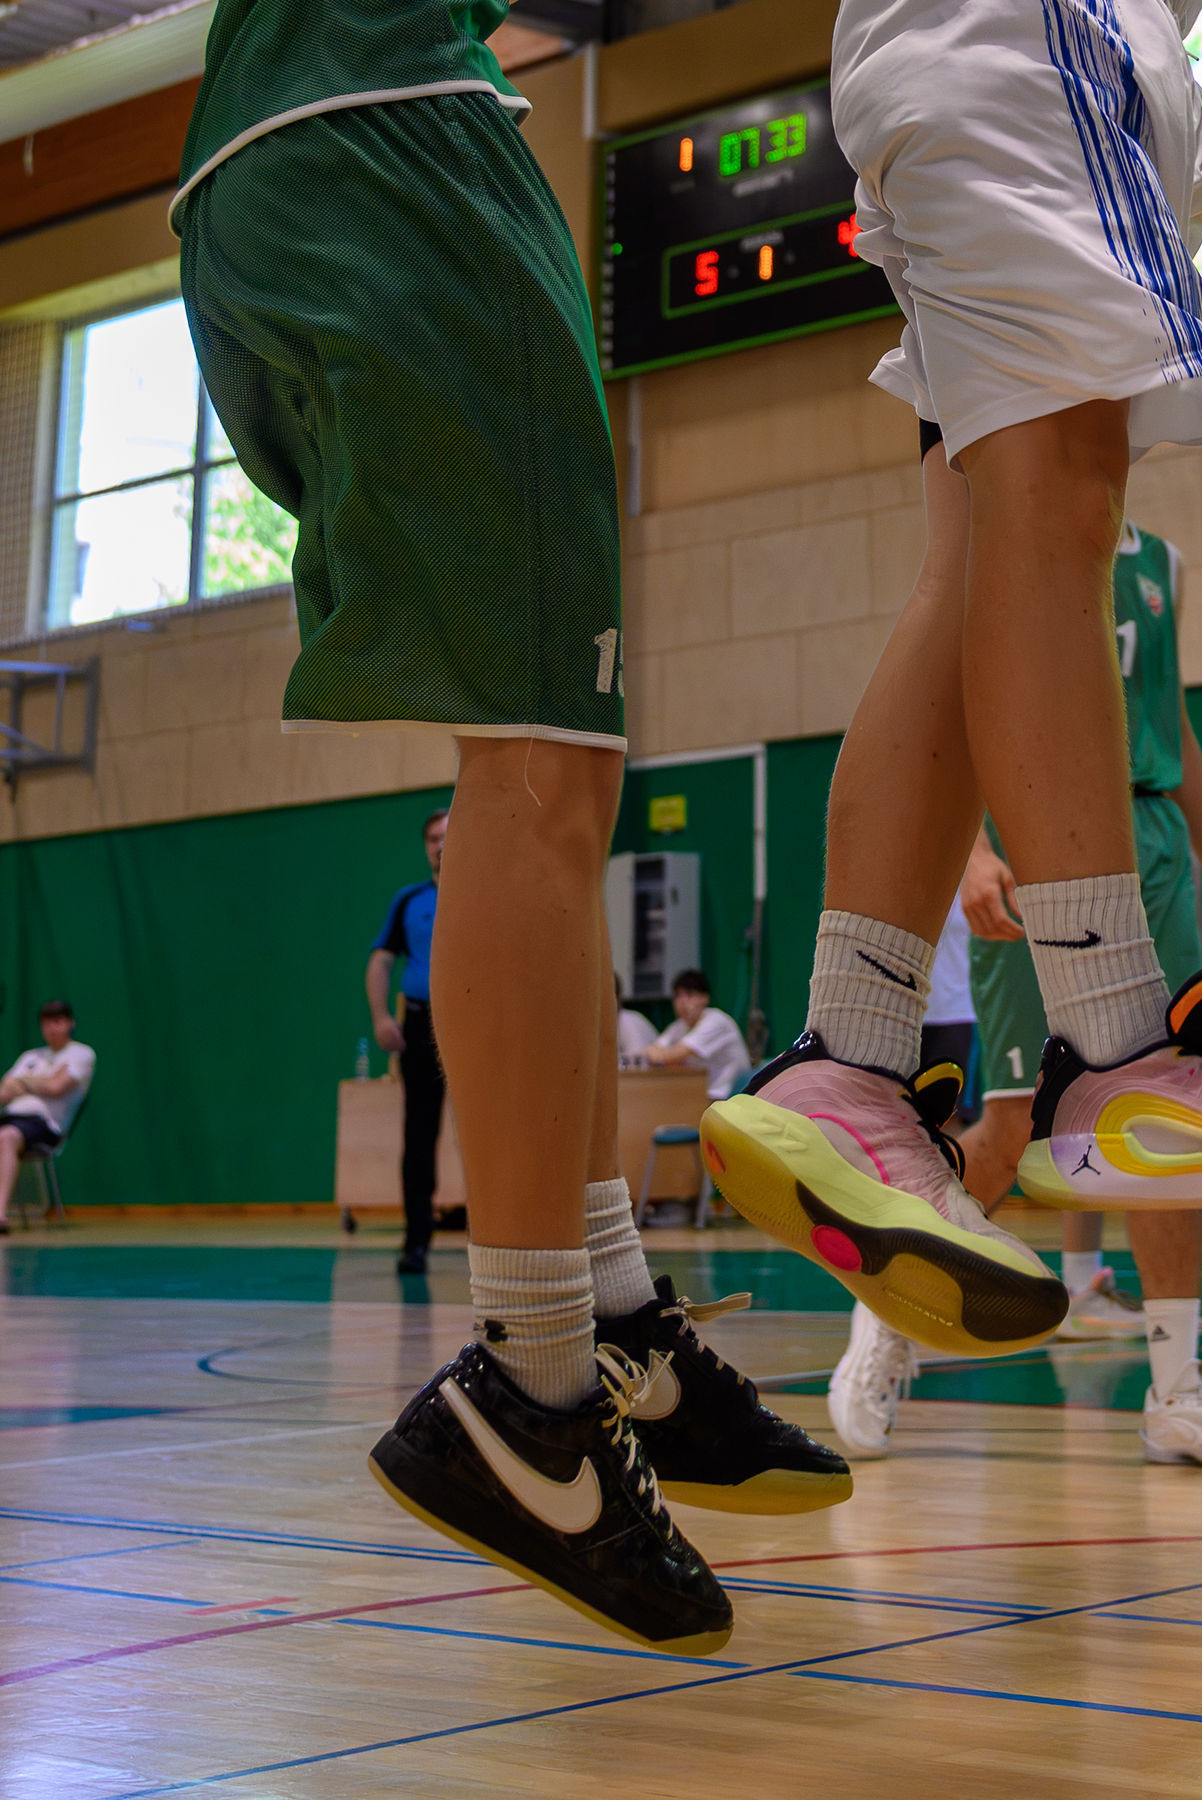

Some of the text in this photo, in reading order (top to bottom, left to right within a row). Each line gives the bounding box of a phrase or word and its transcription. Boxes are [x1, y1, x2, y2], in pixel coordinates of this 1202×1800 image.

[680, 137, 693, 172] 1
[695, 250, 719, 296] 5
[594, 628, 624, 697] 1
[1006, 1046, 1024, 1079] 1
